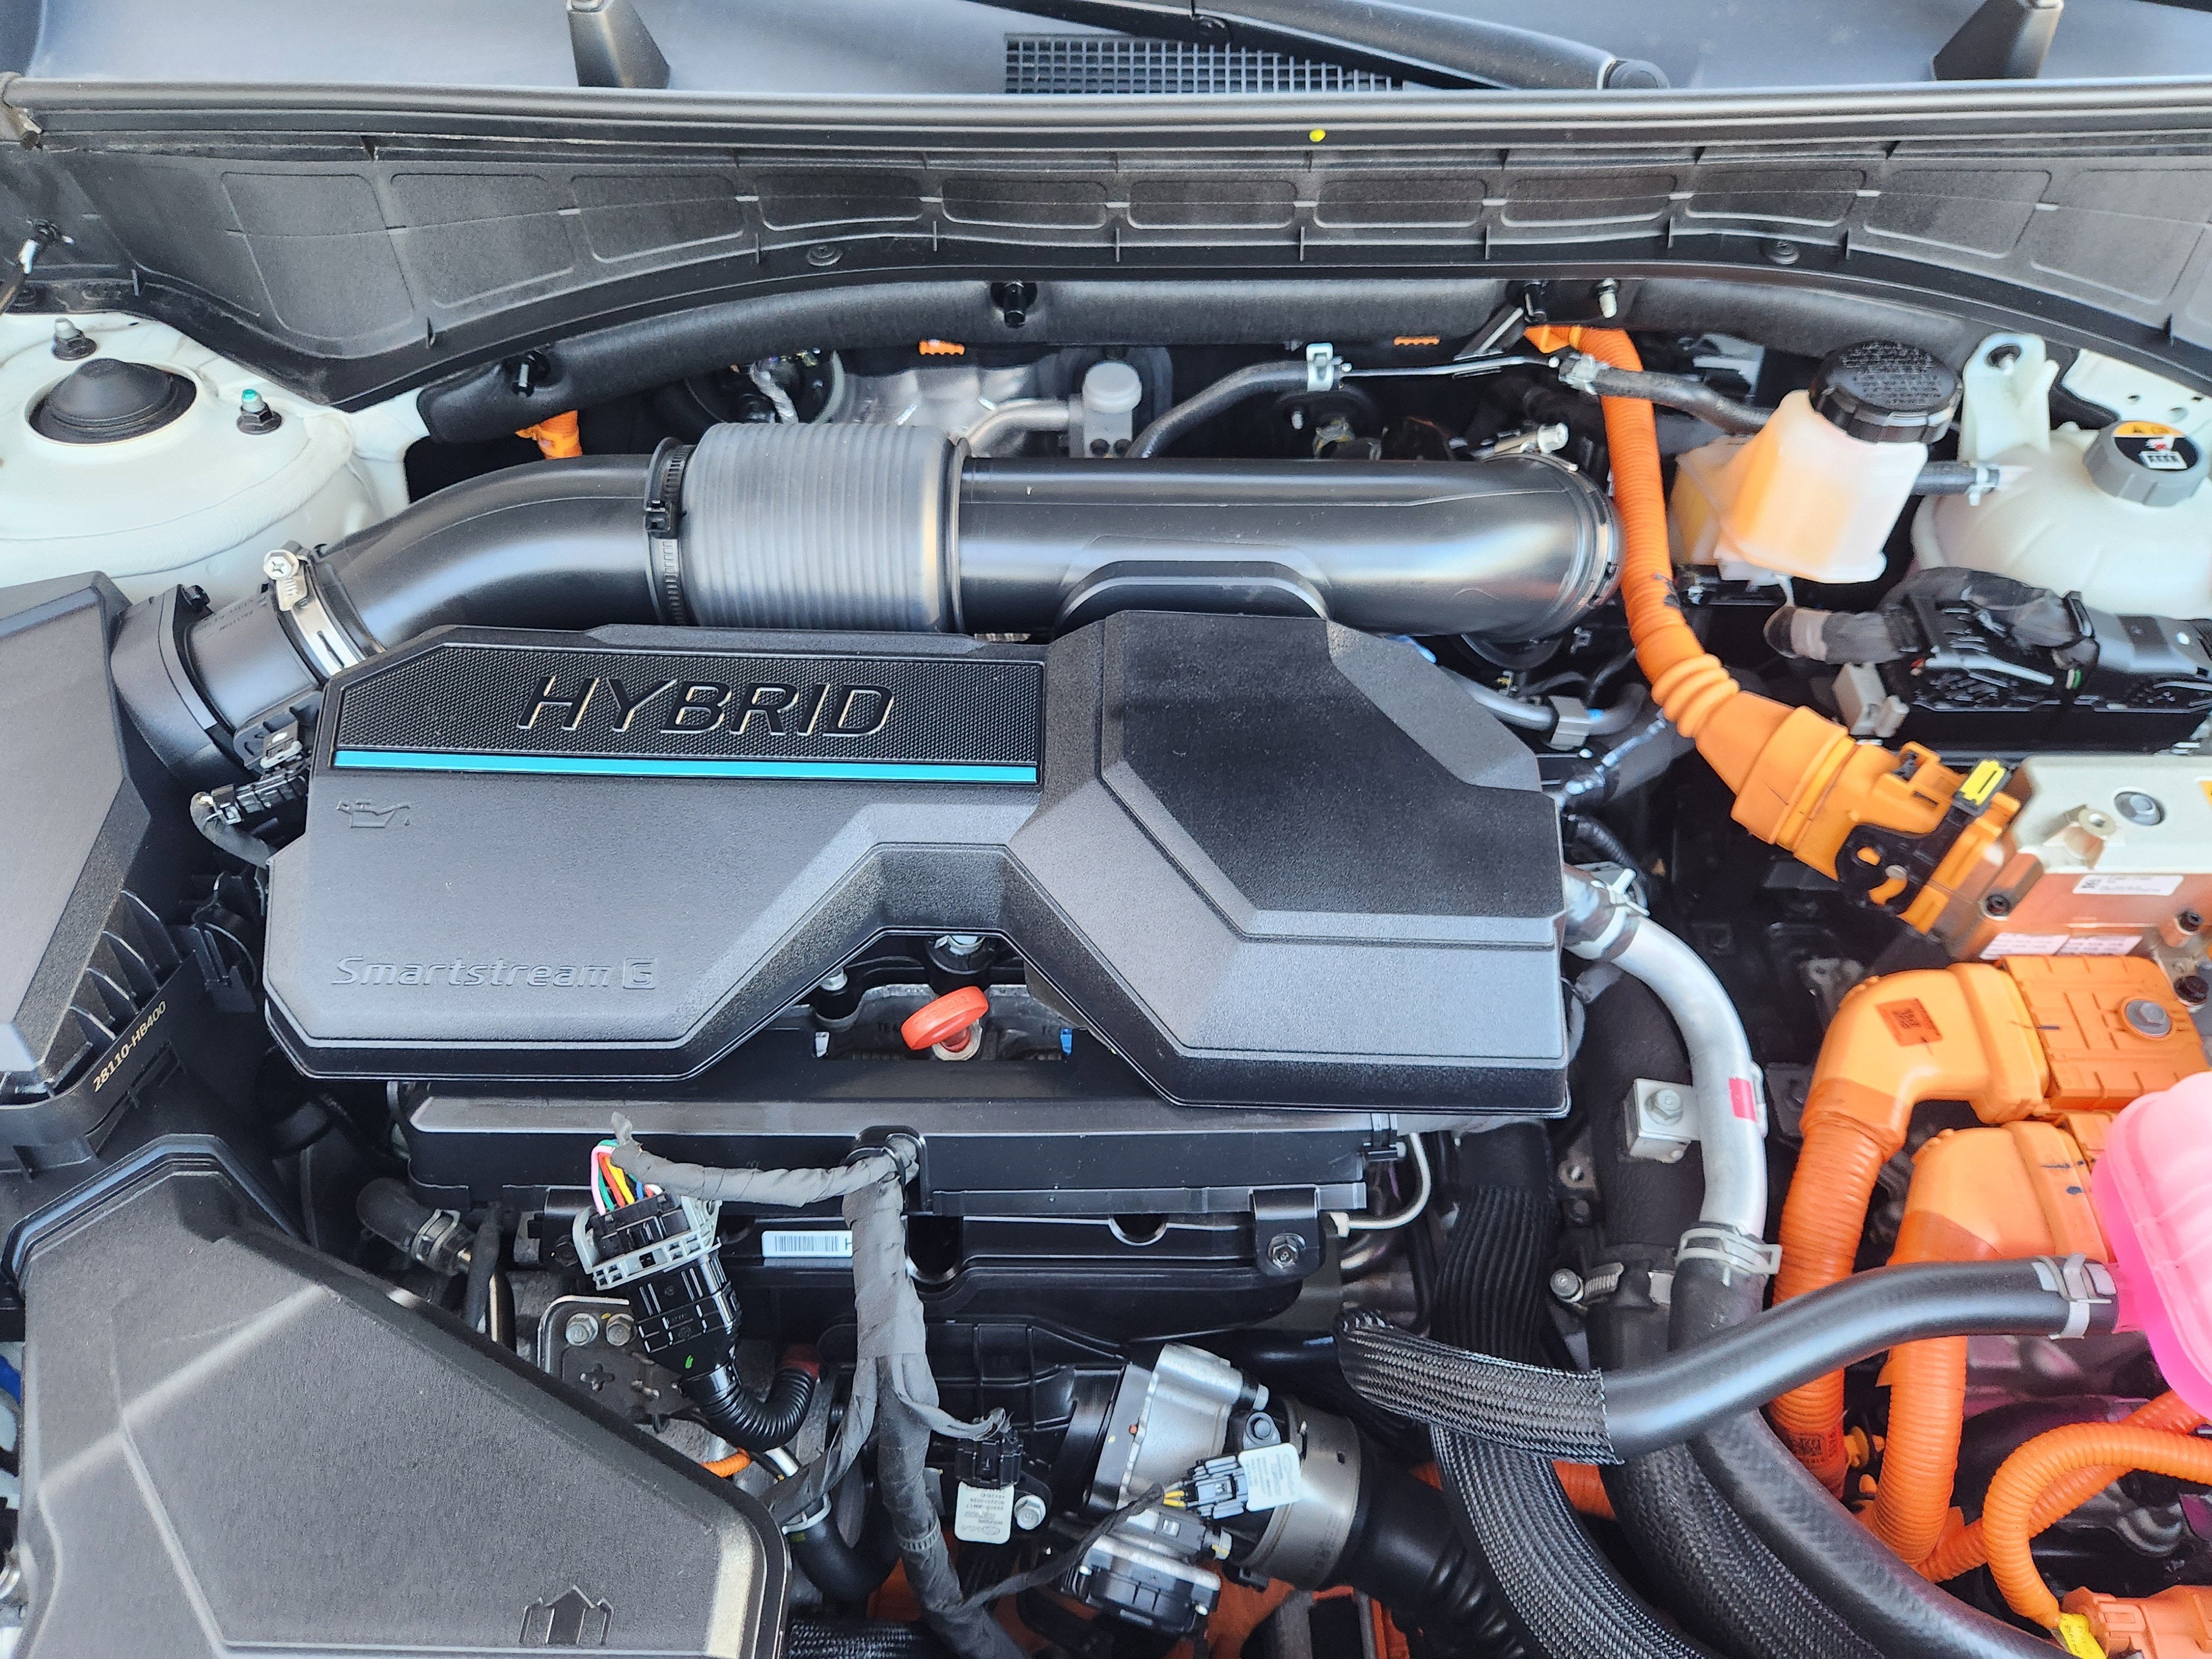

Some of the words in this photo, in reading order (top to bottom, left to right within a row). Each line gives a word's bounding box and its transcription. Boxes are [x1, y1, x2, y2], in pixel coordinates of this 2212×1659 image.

[517, 676, 894, 737] HYBRID
[331, 956, 613, 987] Smartstream
[628, 961, 654, 987] G
[93, 1000, 166, 1092] 28110-HB400
